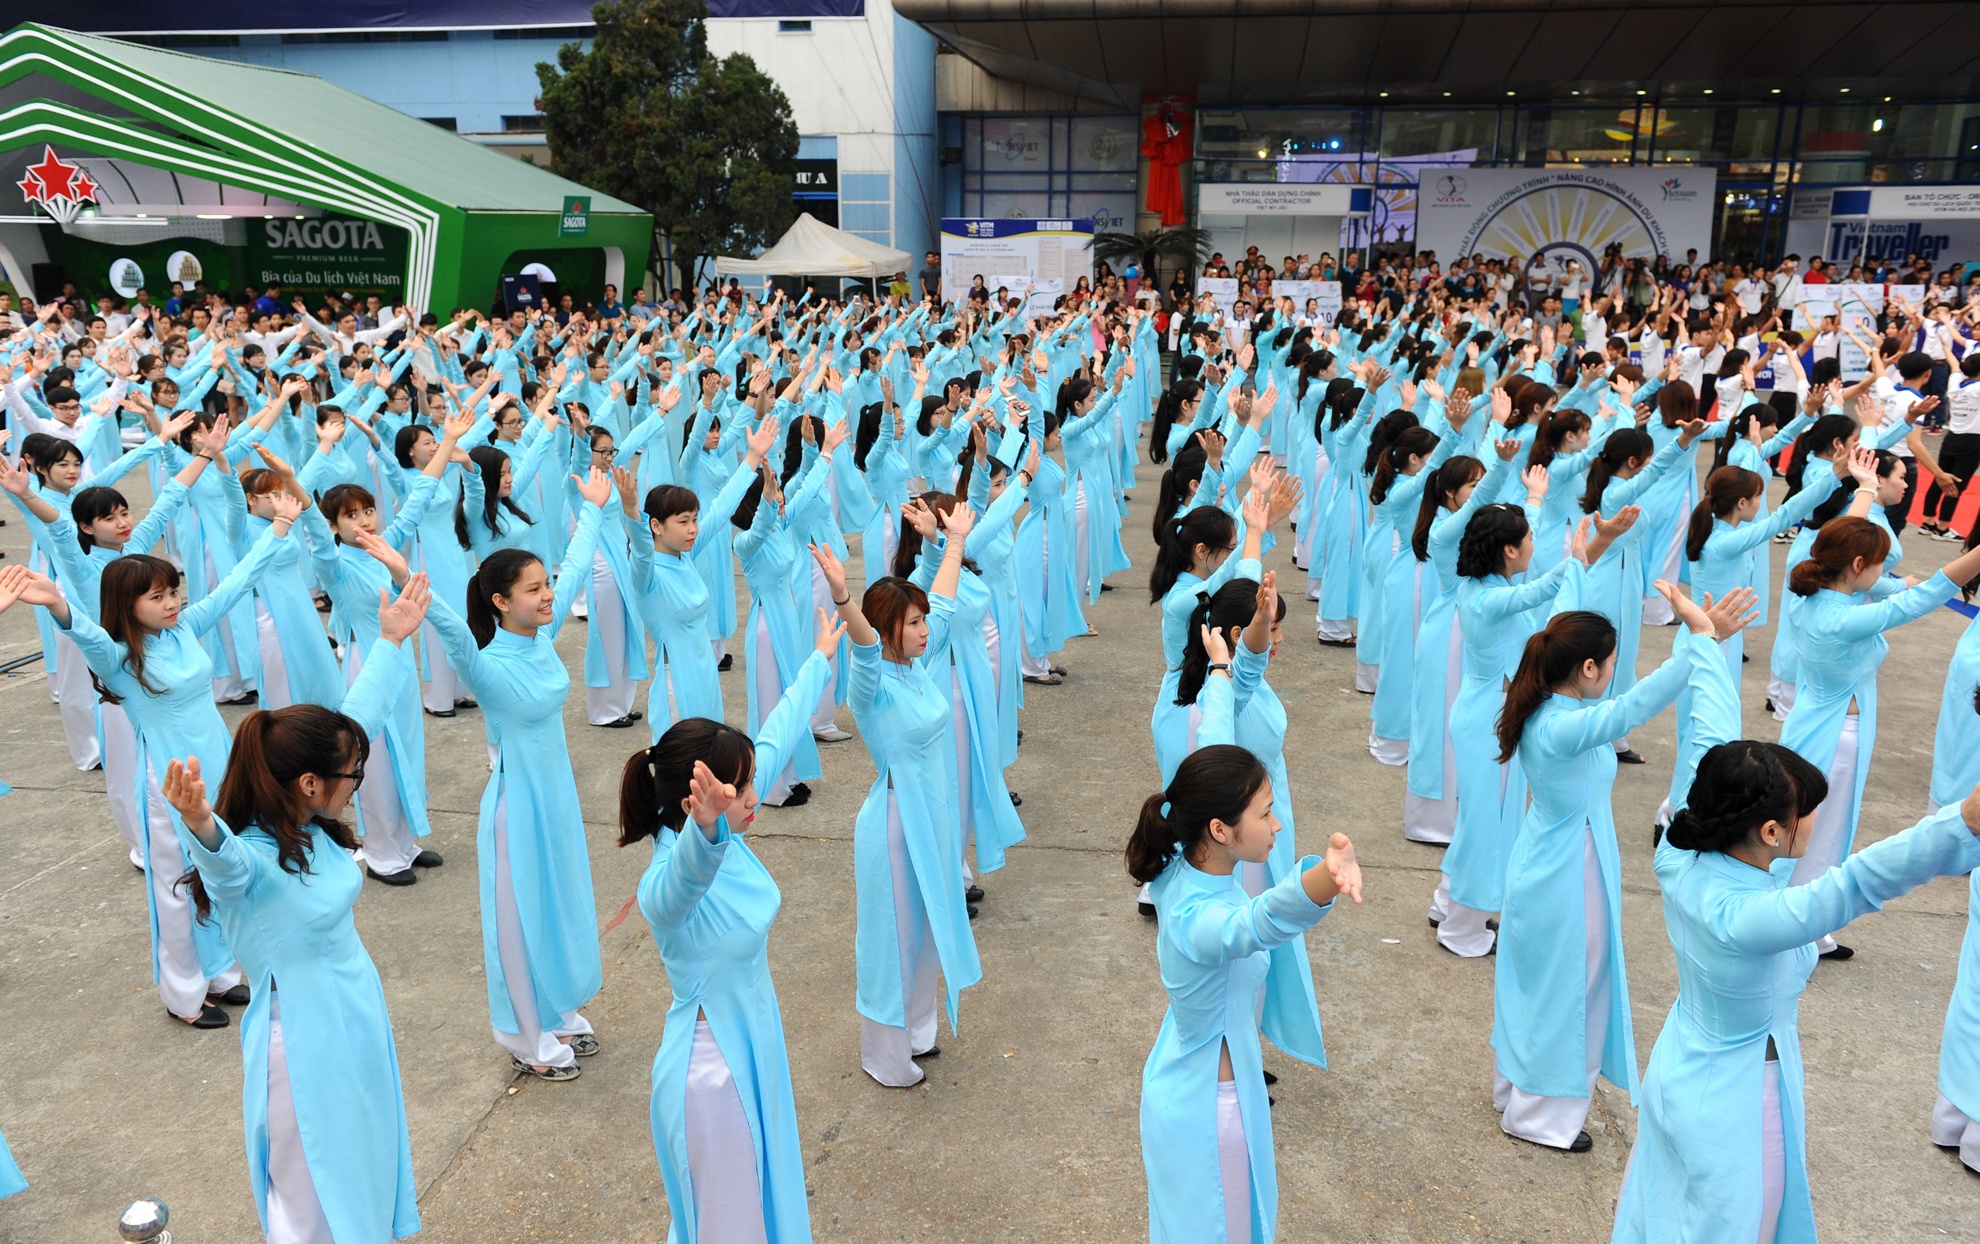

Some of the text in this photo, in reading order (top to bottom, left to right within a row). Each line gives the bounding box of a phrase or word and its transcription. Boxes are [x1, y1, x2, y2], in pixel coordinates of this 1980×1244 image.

[815, 172, 827, 184] A
[1522, 177, 1550, 190] TRÌNH
[1585, 176, 1605, 187] CAO
[1605, 181, 1627, 197] HÌNH
[1641, 207, 1654, 221] DU
[563, 217, 586, 228] SAGOTA
[265, 220, 385, 249] SAGOTA
[1830, 223, 1949, 261] Traveller
[262, 270, 400, 286] Bia của Du lịch Việt Nam
[1321, 312, 1333, 323] 10
